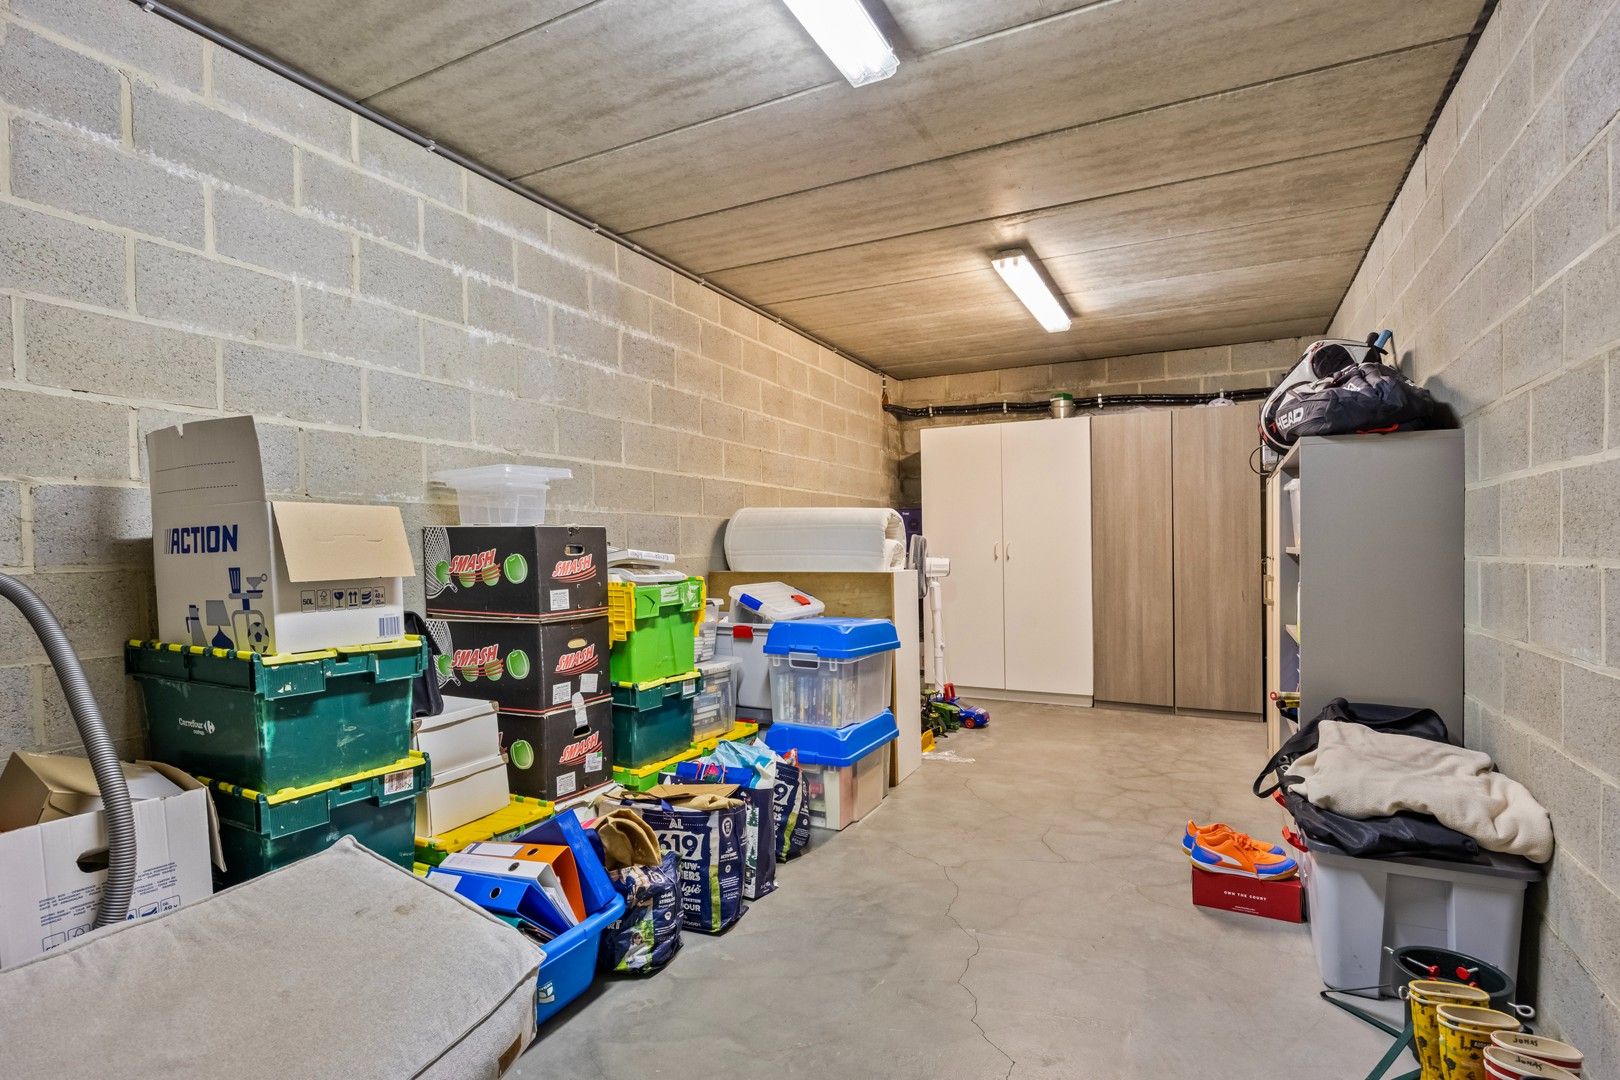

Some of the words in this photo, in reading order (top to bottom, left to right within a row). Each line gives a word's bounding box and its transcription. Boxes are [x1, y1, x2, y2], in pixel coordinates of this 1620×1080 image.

[1278, 407, 1304, 431] HEAD
[171, 524, 238, 554] ACTION
[449, 548, 497, 574] SMASH
[552, 553, 593, 577] SMASH
[451, 643, 499, 668] SMASH
[555, 643, 596, 672] SMASH
[178, 717, 203, 729] Carrefour
[559, 730, 600, 763] SMASH
[658, 832, 698, 857] 619
